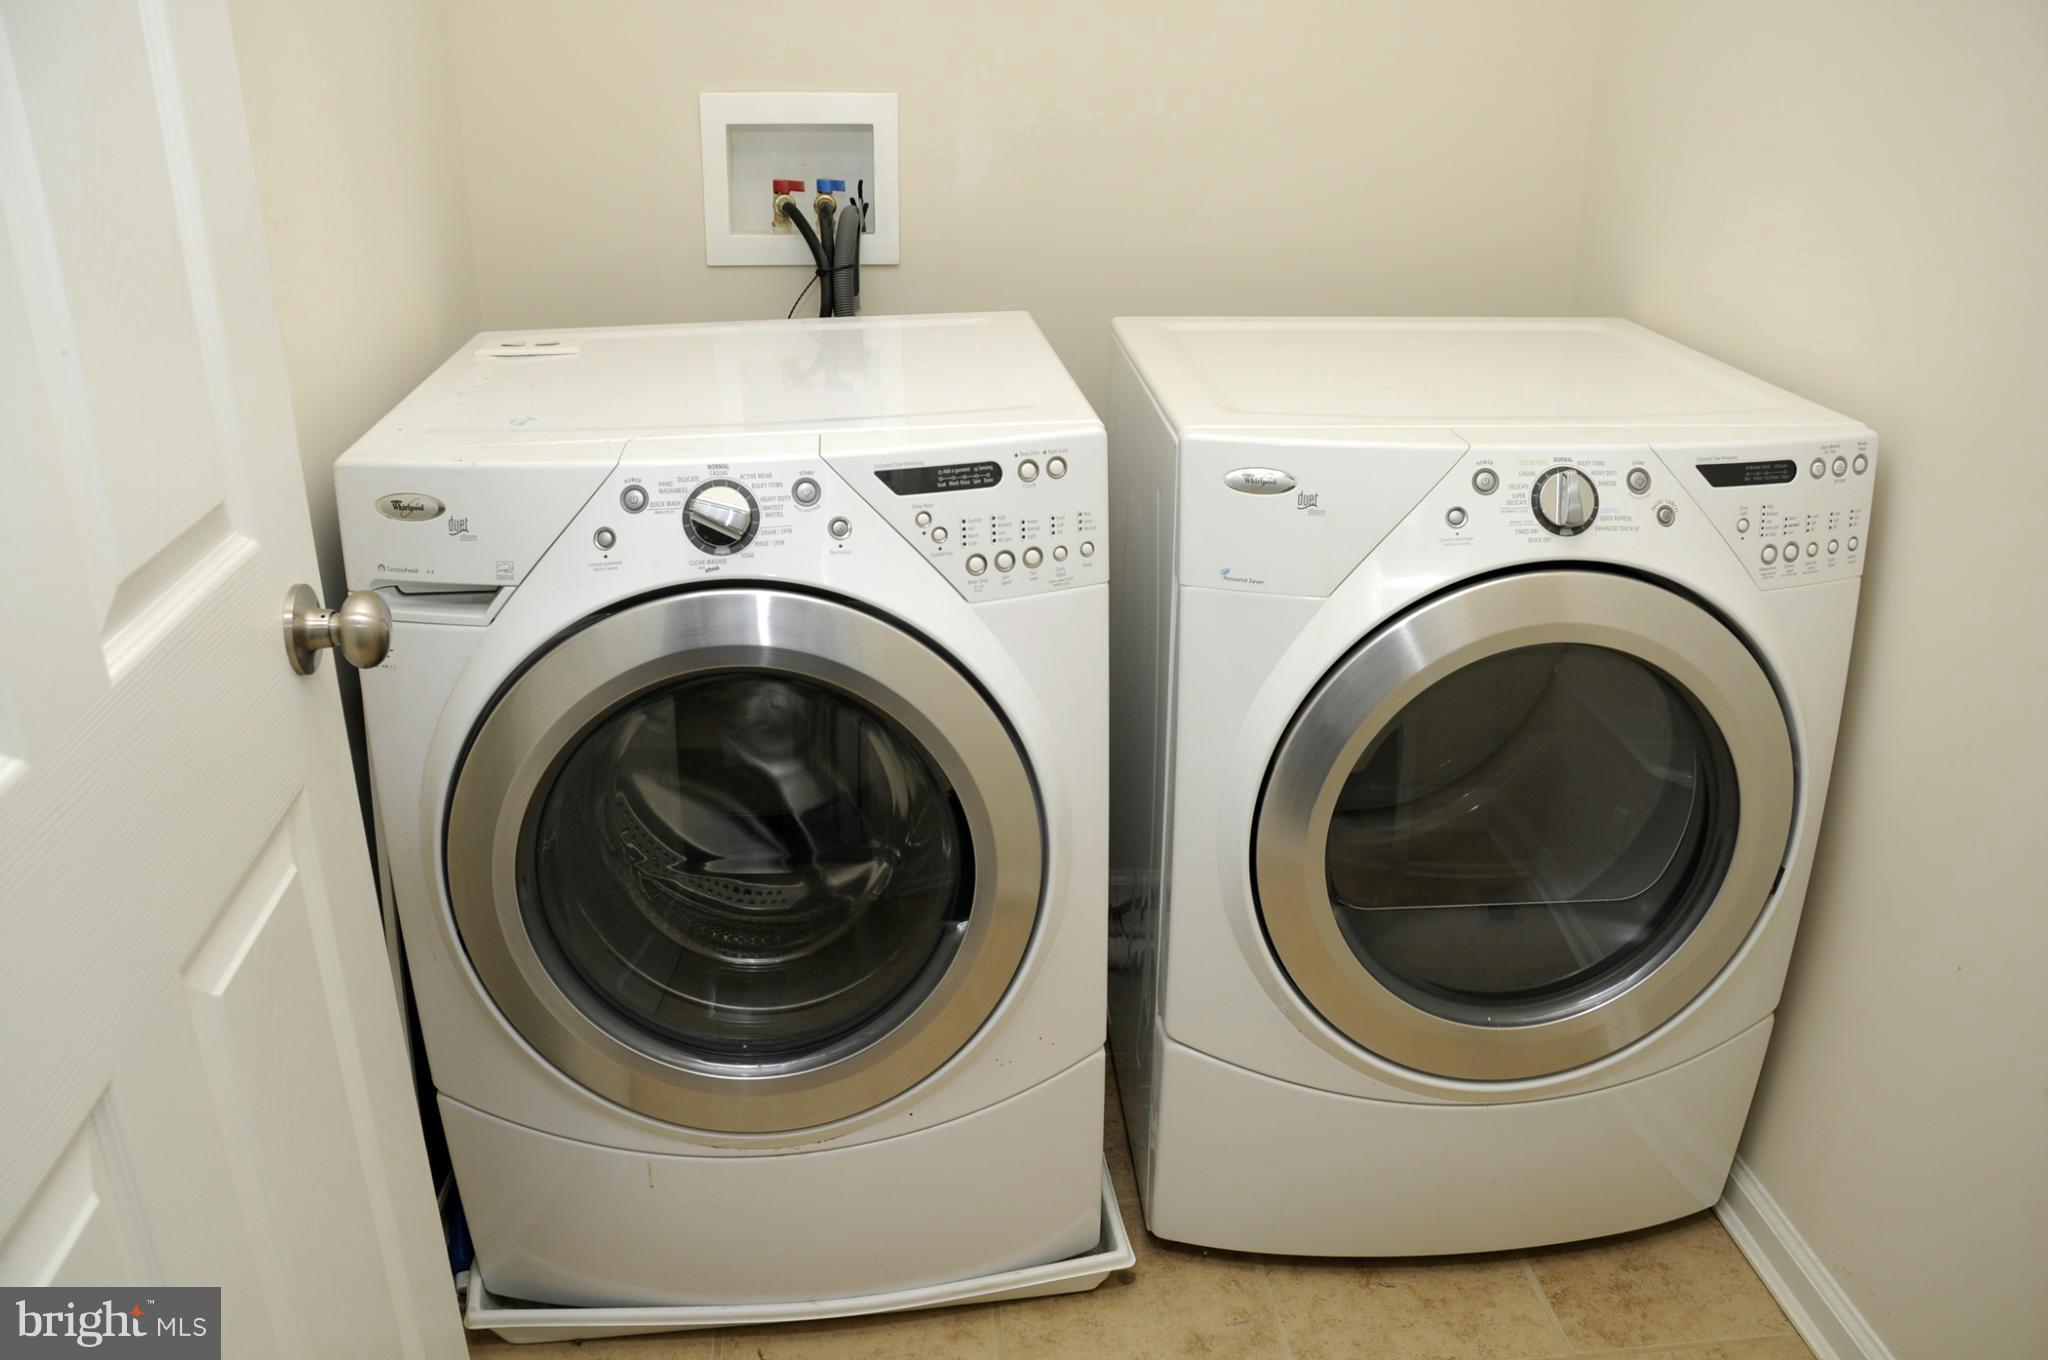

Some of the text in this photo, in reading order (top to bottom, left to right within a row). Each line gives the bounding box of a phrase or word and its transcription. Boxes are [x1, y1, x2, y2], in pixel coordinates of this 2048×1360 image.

[1297, 490, 1319, 506] duet
[391, 502, 425, 513] Whirlpool
[447, 516, 468, 532] duet
